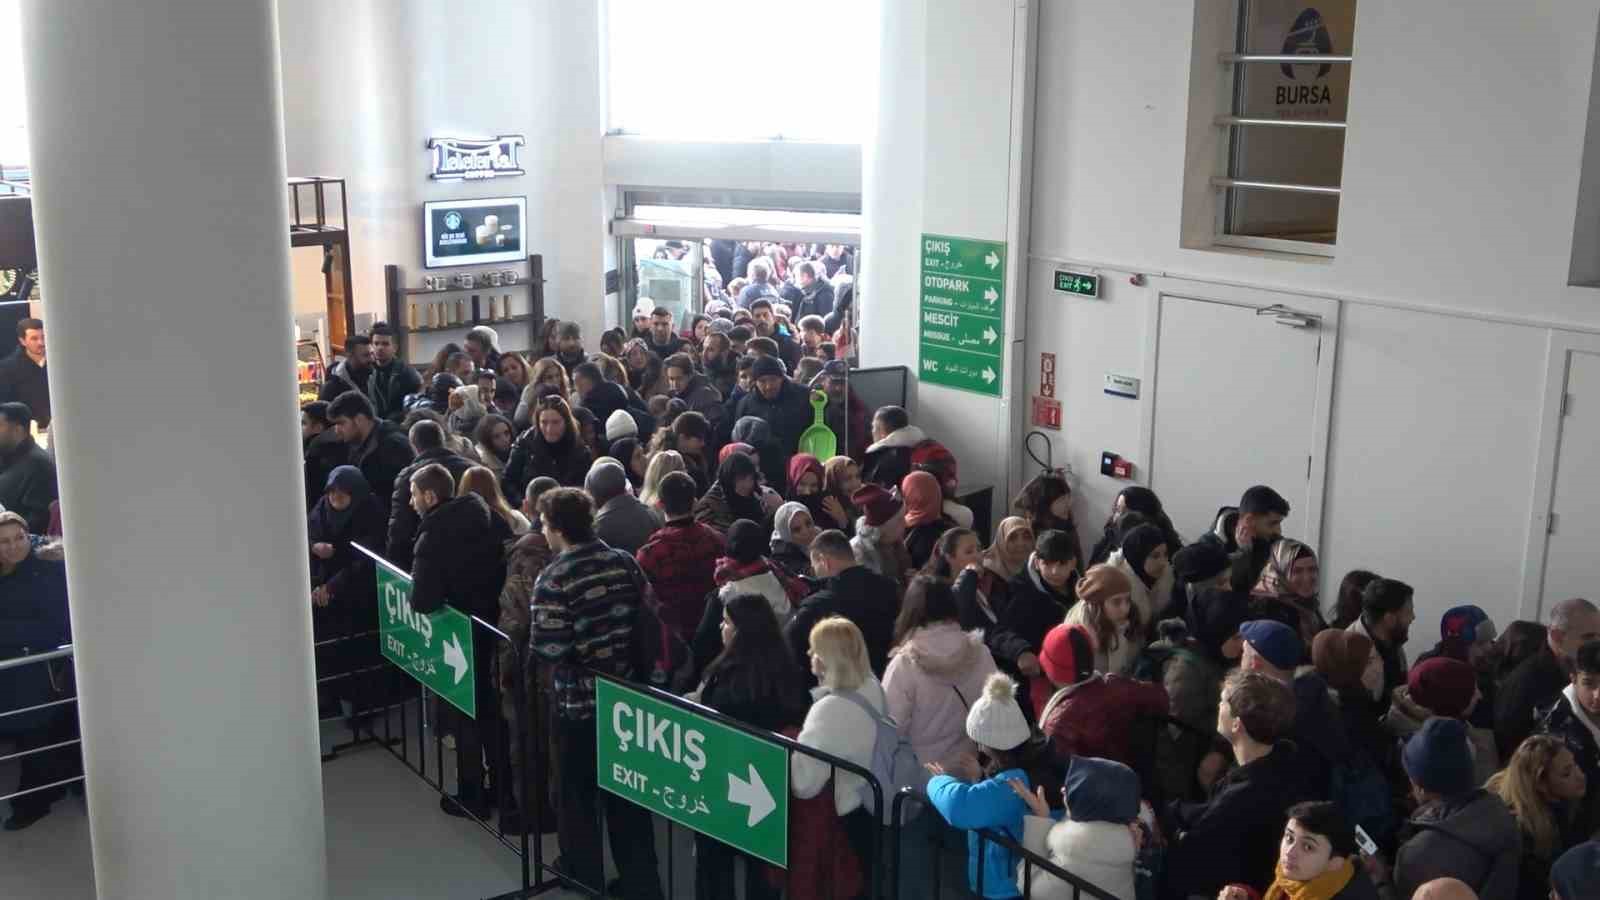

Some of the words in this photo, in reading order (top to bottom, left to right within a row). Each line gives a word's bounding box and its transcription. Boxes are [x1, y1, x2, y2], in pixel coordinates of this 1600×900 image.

[1276, 85, 1331, 105] BURSA
[925, 240, 951, 256] ÇIKIŞ
[924, 276, 970, 292] OTOPARK
[924, 311, 959, 328] MESCİT
[922, 359, 938, 372] WC
[387, 633, 406, 657] EXIT
[612, 702, 707, 782] ÇIKIŞ
[612, 763, 648, 793] EXIT
[663, 785, 711, 814] خروج
